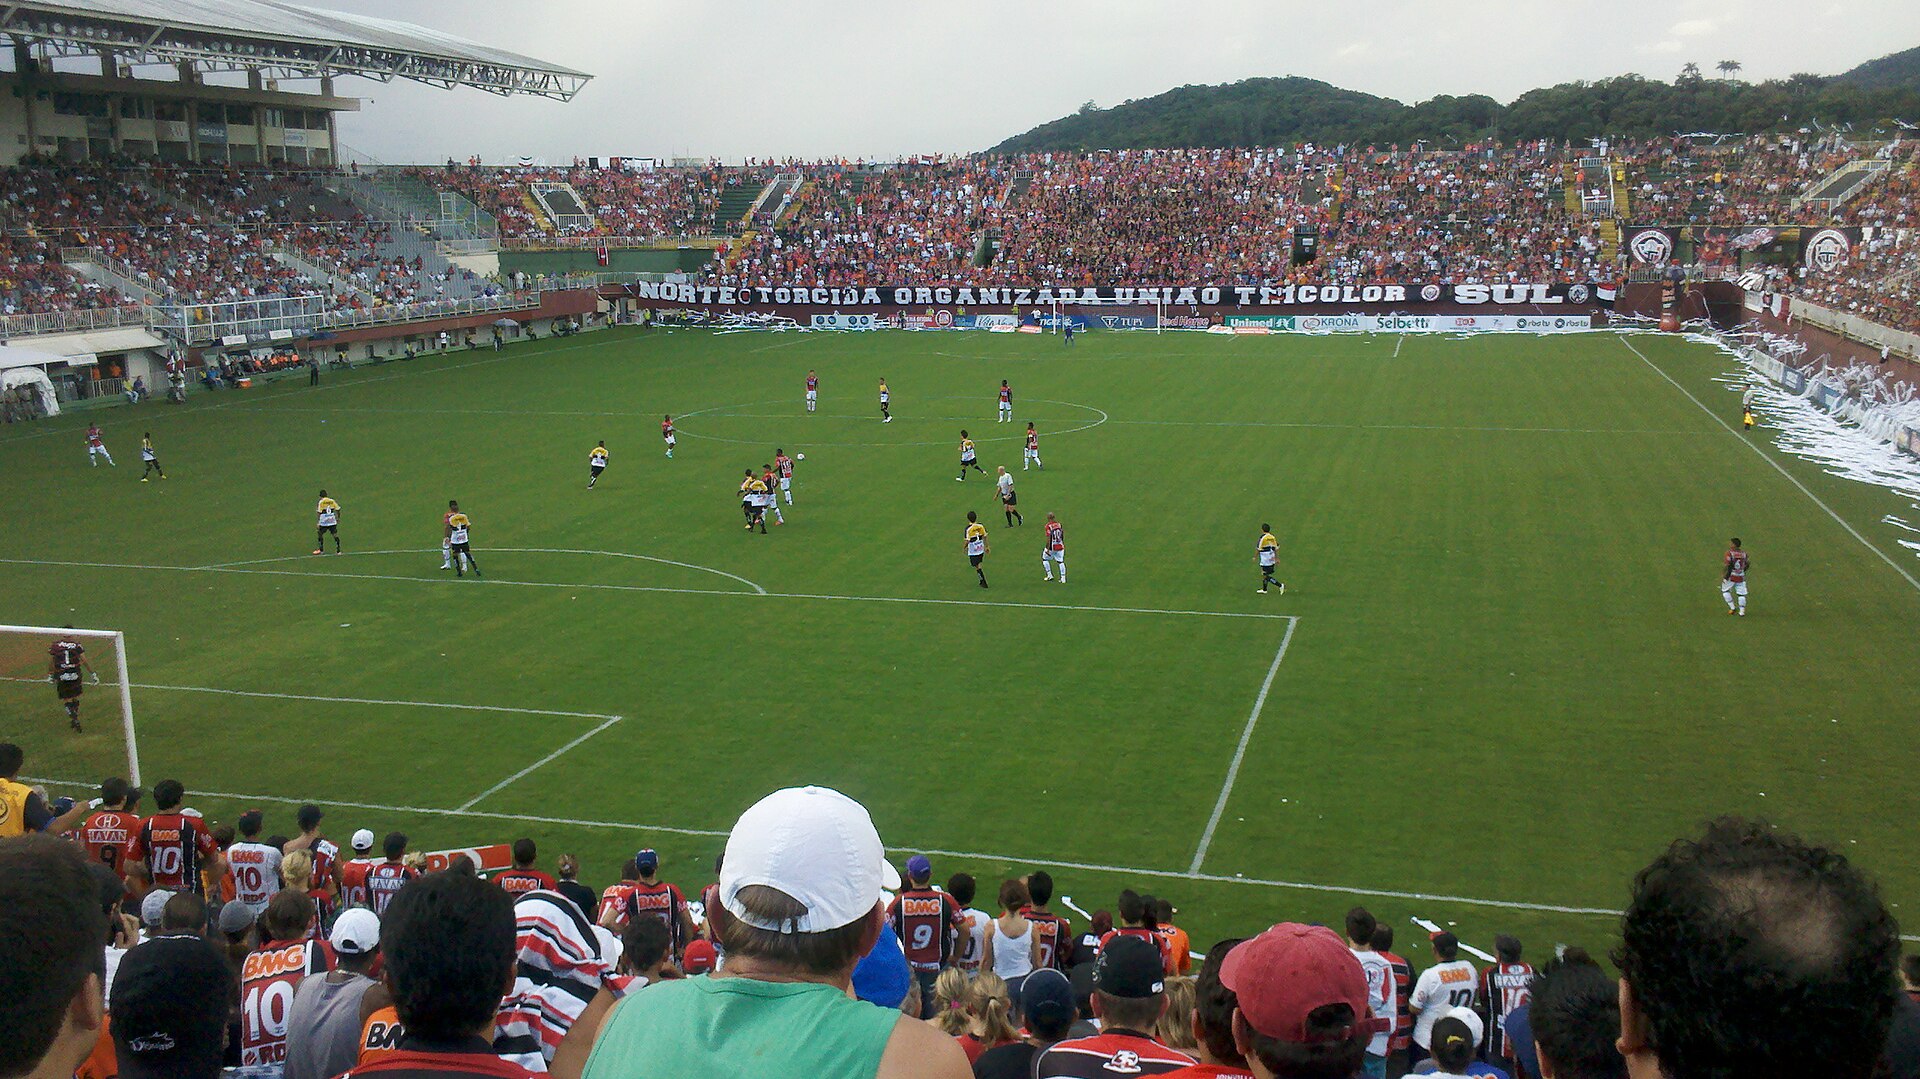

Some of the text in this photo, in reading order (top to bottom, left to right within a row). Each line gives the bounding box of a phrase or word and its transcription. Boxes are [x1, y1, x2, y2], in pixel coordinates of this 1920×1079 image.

[639, 281, 736, 304] NORTE
[755, 287, 881, 305] TORCIDA
[895, 287, 1099, 305] ORGANIZADA
[1455, 284, 1563, 304] SUL
[1121, 318, 1144, 326] TUPY
[1230, 318, 1273, 327] Unimed
[1321, 318, 1359, 326] KRONA
[89, 829, 127, 842] HAVAN
[152, 830, 180, 841] BMG
[152, 847, 181, 875] 10
[237, 867, 262, 892] 10
[504, 878, 538, 892] BMG
[904, 900, 940, 915] BMG
[1033, 921, 1056, 934] MG
[911, 924, 932, 950] 9
[243, 945, 304, 979] BMG
[244, 981, 293, 1041] 10
[366, 1022, 404, 1049] BM
